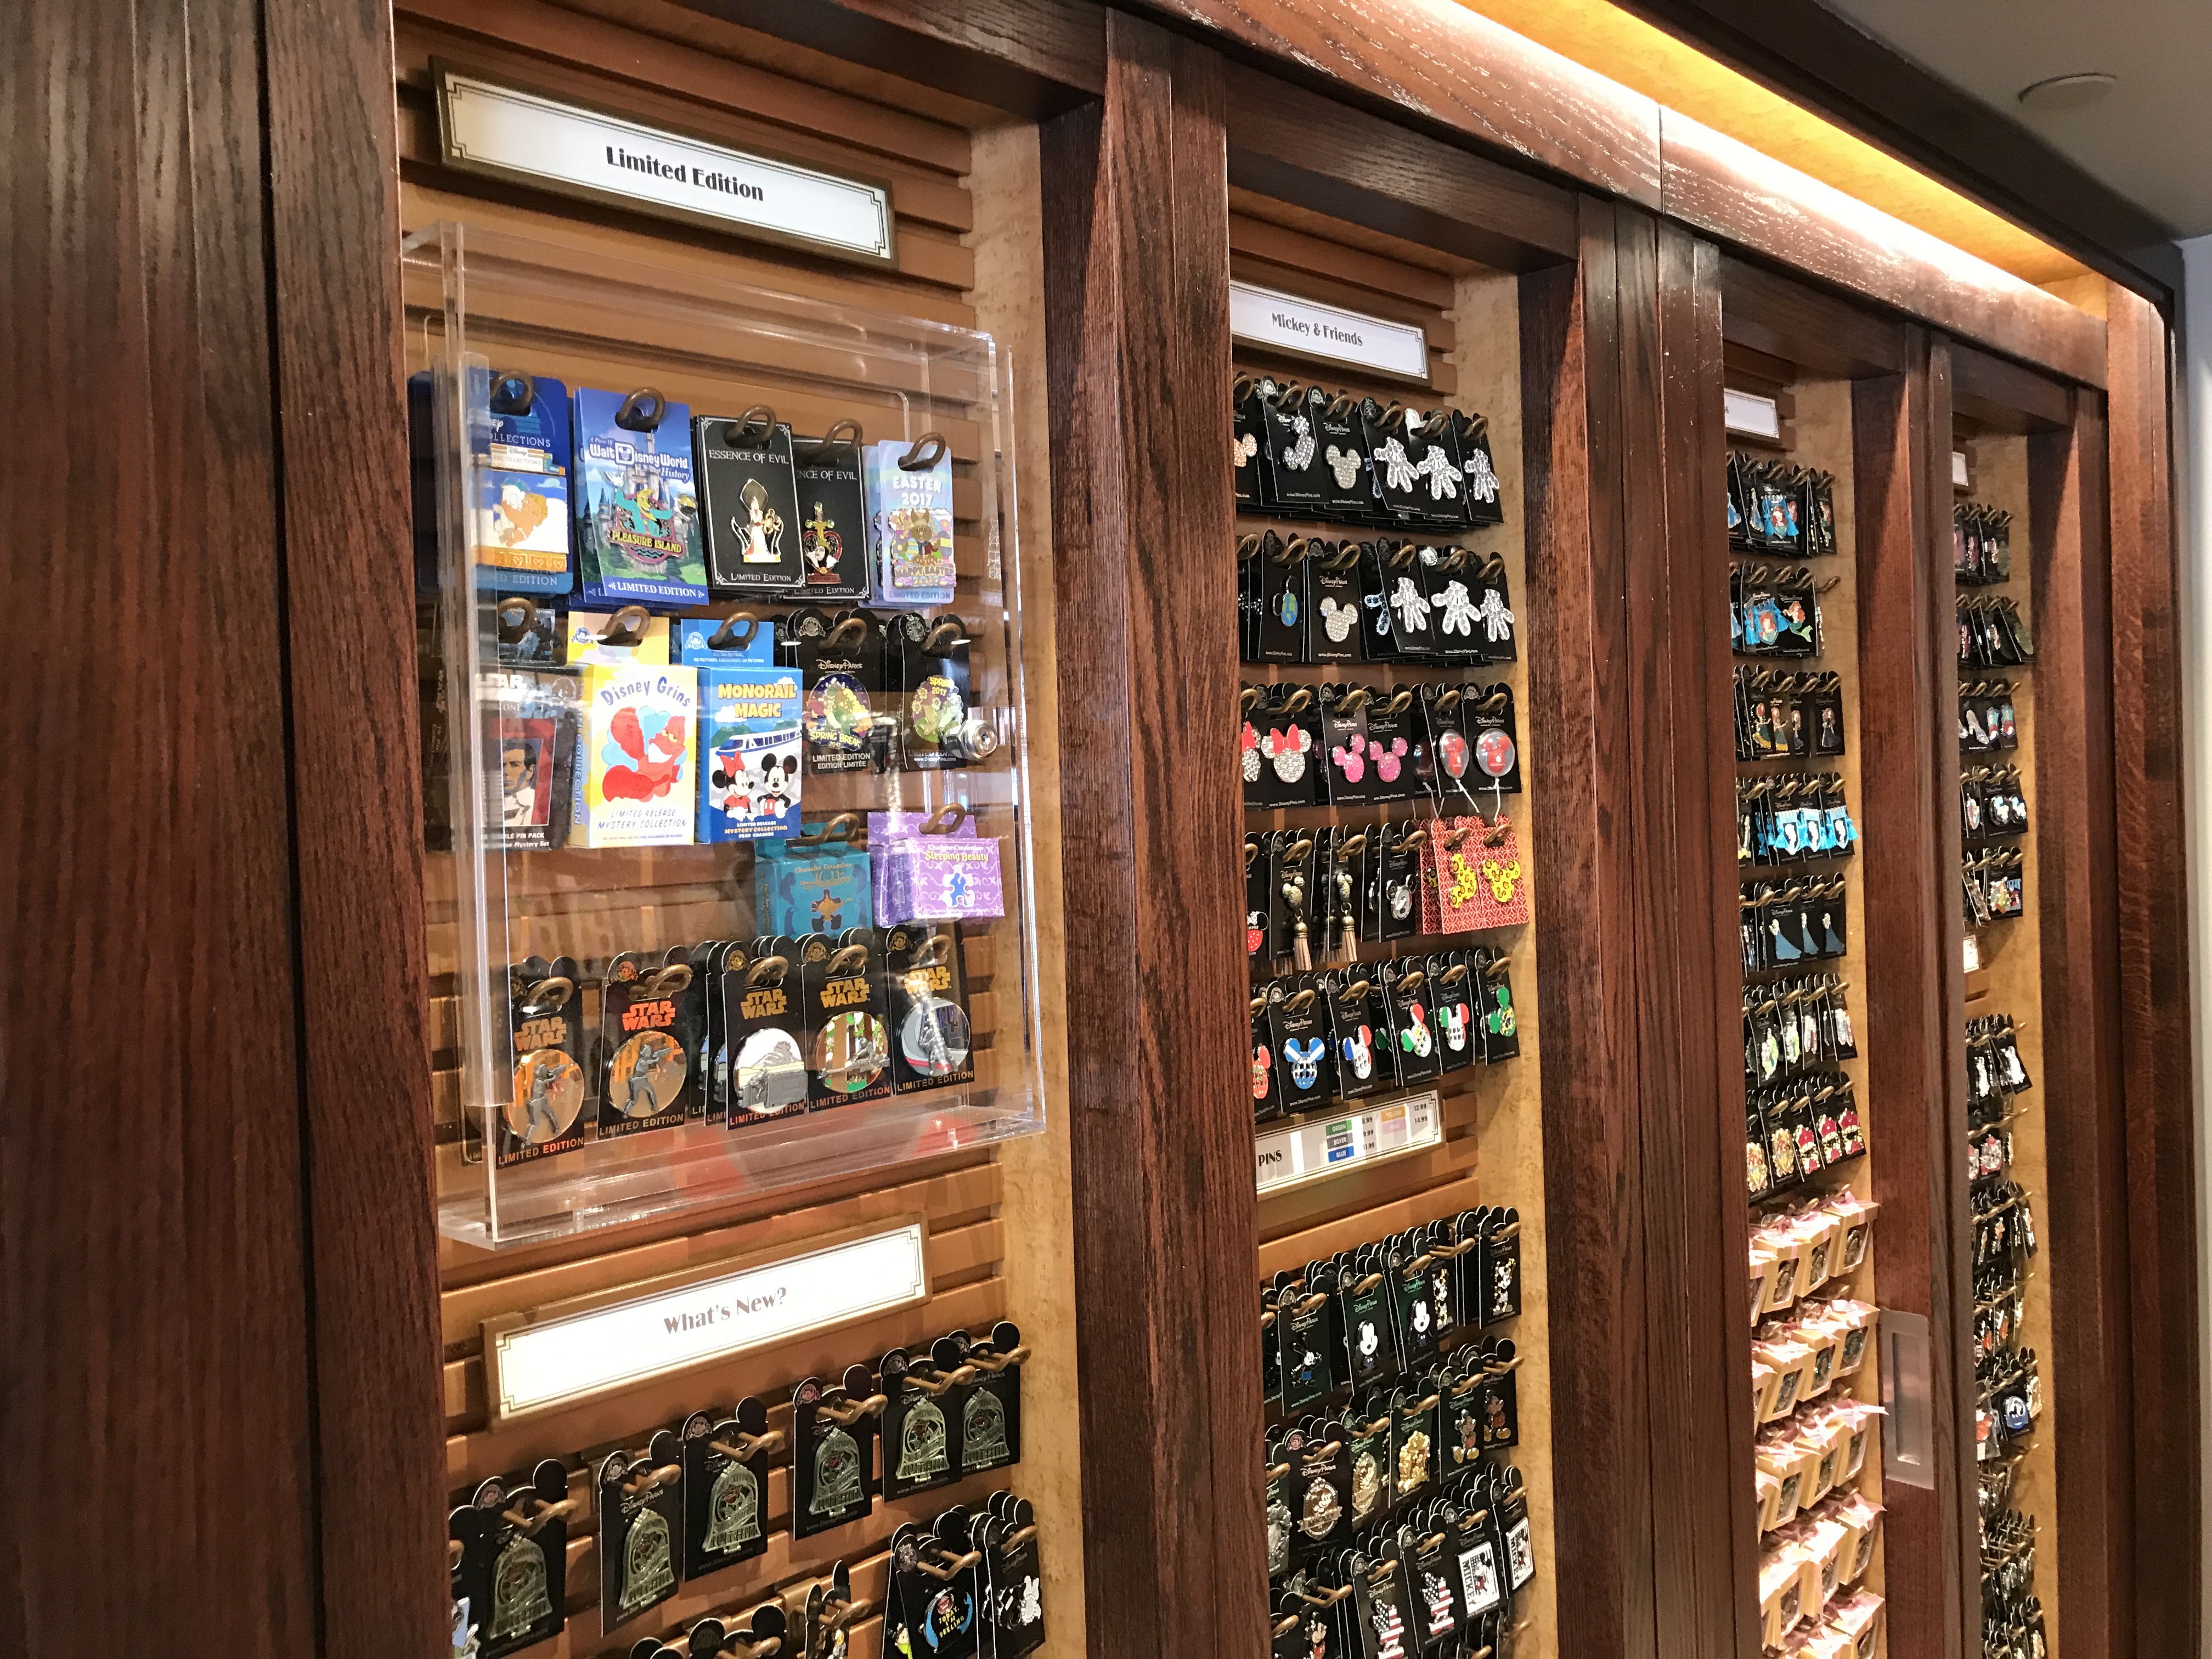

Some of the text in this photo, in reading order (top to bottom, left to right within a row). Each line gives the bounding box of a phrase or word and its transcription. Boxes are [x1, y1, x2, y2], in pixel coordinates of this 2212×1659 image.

[606, 146, 764, 201] Limited Edition
[1272, 313, 1363, 347] Mickey & Friends
[590, 444, 614, 459] Walt
[660, 453, 689, 469] World
[709, 449, 789, 465] ESSENCE OF EVIL
[661, 467, 690, 481] History
[821, 470, 833, 481] OF
[837, 471, 857, 480] EVIL
[893, 476, 941, 493] EASTER
[901, 492, 933, 506] 2017
[612, 530, 682, 553] PLEASURE ISLAND
[512, 574, 557, 585] EDITION
[617, 582, 696, 597] LIMITED EDITION
[889, 590, 951, 600] LIMITED EDITION
[718, 683, 797, 699] MONORAIL
[929, 676, 953, 689] SPRIN
[601, 676, 691, 707] Disney Grins
[932, 687, 947, 697] 2017
[735, 703, 782, 718] MAGIC
[810, 730, 861, 748] SPRING BREAK
[812, 754, 841, 763] LIMITED
[574, 734, 583, 825] COLLECTION
[611, 810, 642, 818] LIMITED
[598, 819, 687, 829] MYSTERY COLLECTION
[925, 850, 989, 862] Sleeping Beauty
[905, 966, 951, 984] STAR
[821, 978, 870, 997] STAR
[905, 979, 951, 995] WARS
[741, 989, 787, 1006] STAR
[821, 990, 870, 1008] WARS
[622, 1000, 675, 1019] STAR
[741, 1001, 787, 1019] WARS
[515, 1017, 567, 1039] STAR
[622, 1013, 675, 1031] WARS
[515, 1030, 567, 1051] WARS
[897, 1070, 974, 1092] LIMITED EDITION
[810, 1085, 890, 1109] LIMITED EDITION
[600, 1113, 684, 1136] LIMITED EDITION
[707, 1111, 726, 1122] LIMI
[730, 1112, 765, 1126] LIMITED
[1415, 1115, 1427, 1124] 14.99
[1332, 1124, 1346, 1132] GREEN
[1334, 1136, 1347, 1146] SILVER
[498, 1136, 584, 1165] LIMITED EDITION
[1258, 1150, 1283, 1166] PINS
[1336, 1149, 1347, 1158] BLUE
[664, 1287, 787, 1336] What's New?
[1510, 1537, 1520, 1582] MICKEY
[1463, 1559, 1476, 1606] MICKEY
[939, 1615, 965, 1638] FEELING
